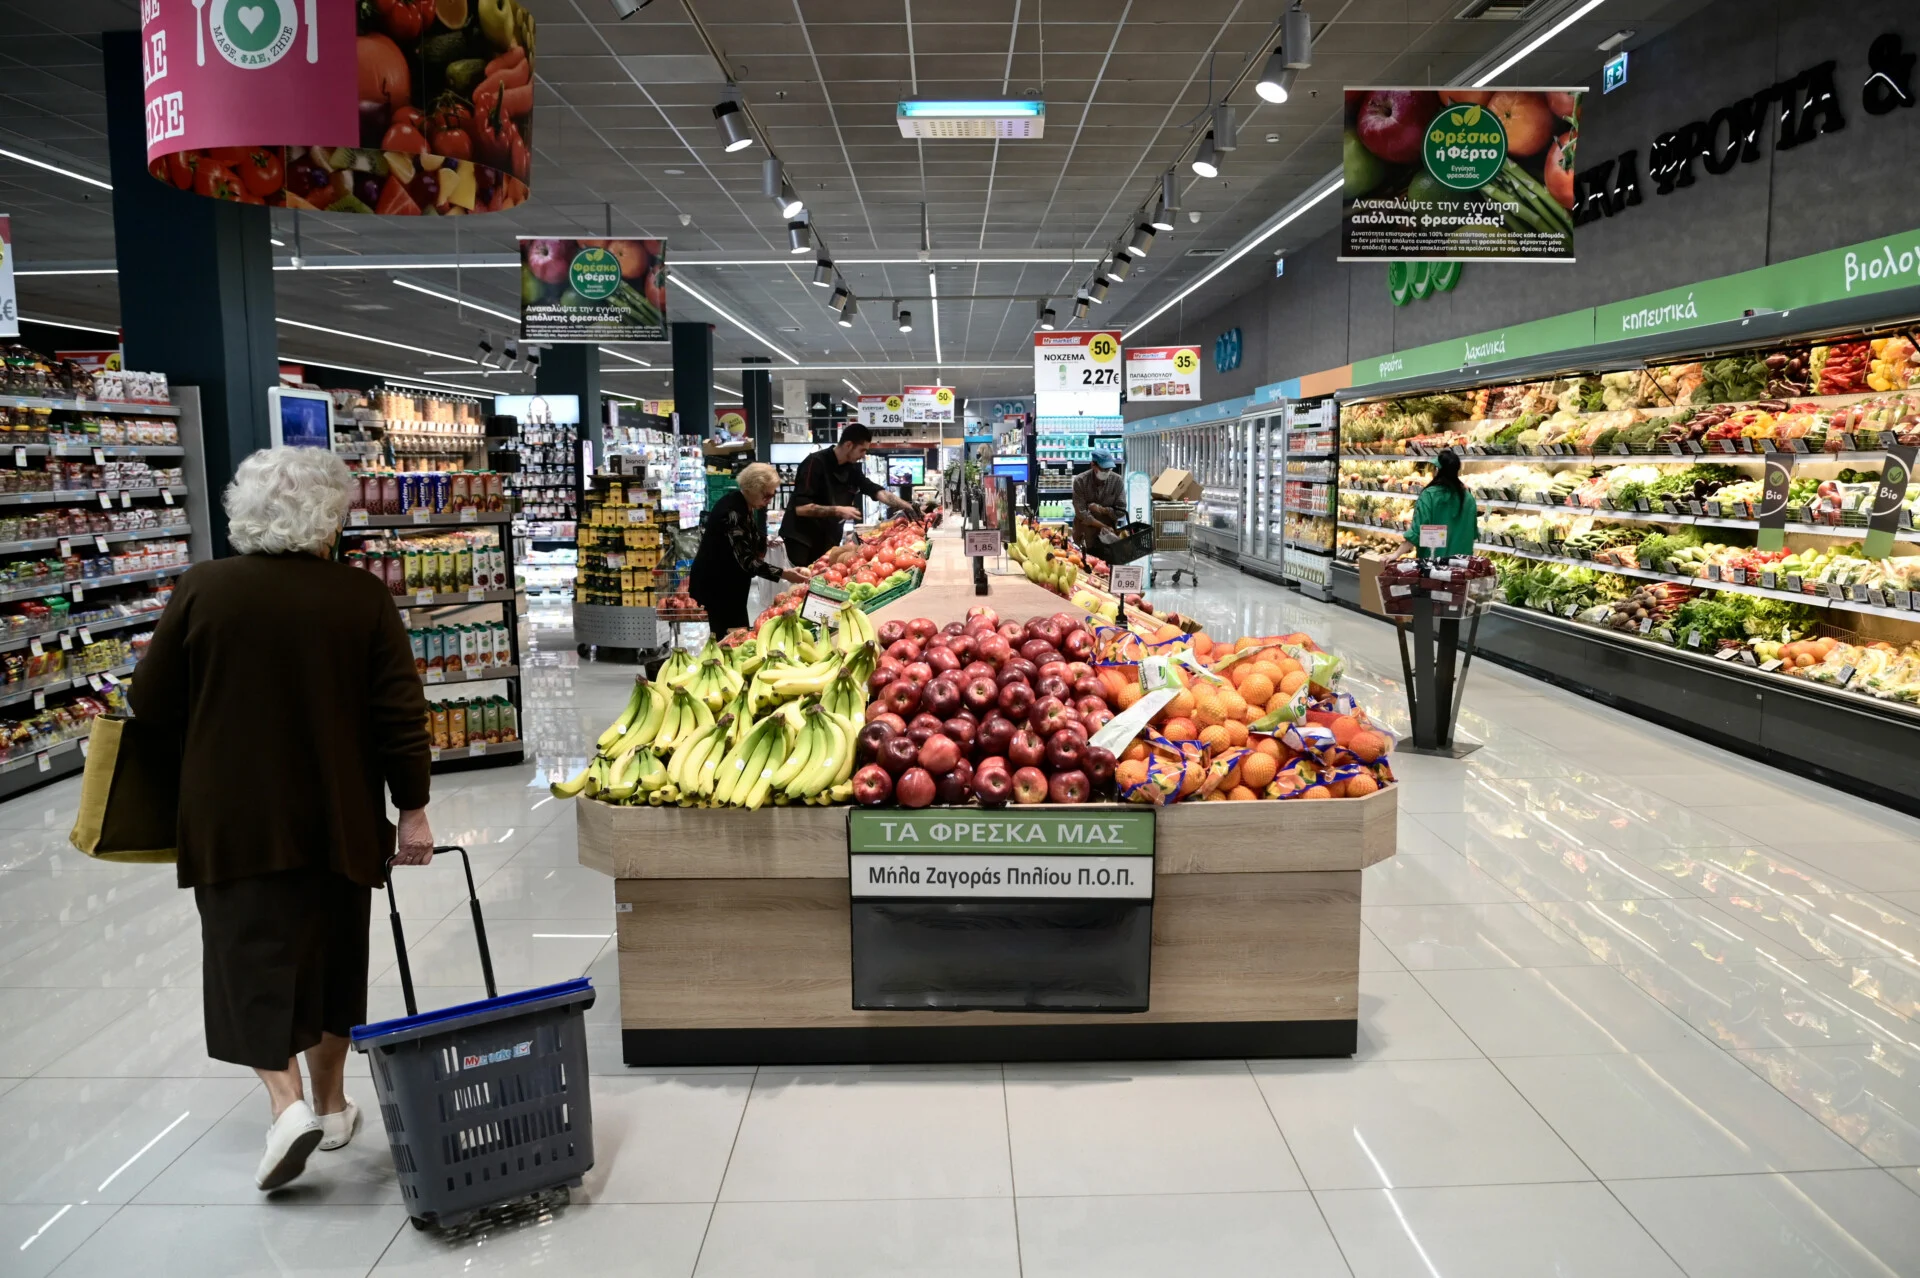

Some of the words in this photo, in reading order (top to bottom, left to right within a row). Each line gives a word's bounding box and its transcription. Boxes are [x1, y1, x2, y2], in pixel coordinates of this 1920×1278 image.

[212, 24, 238, 62] ΜΑΘΕ,
[269, 25, 294, 57] ΖΗΣΕ
[1649, 59, 1846, 196] ΦΡΟΥΤΑ
[1862, 33, 1917, 116] &
[1430, 128, 1501, 147] Φρέσκο
[1435, 146, 1446, 162] ή
[1447, 145, 1498, 162] Φέρτο
[1446, 171, 1480, 179] φρεσκάδας
[1451, 164, 1476, 172] Εγγύηση
[1352, 197, 1433, 213] Ανακαλύψτε
[1437, 200, 1460, 213] την
[1463, 198, 1519, 213] εγγύηση
[1351, 213, 1417, 227] απόλυτης
[1420, 213, 1505, 228] φρεσκάδας!
[1351, 230, 1384, 238] Δυνατότητα
[1385, 231, 1417, 239] επιστροφής
[573, 262, 618, 274] Φρέσκο
[577, 272, 584, 283] ή
[584, 272, 616, 283] Φέρτο
[525, 304, 578, 314] Ανακαλύψτε
[579, 306, 594, 314] την
[595, 305, 632, 314] εγγύηση
[1622, 291, 1698, 332] κηπευτικά
[525, 313, 568, 323] απόλυτης
[569, 313, 623, 323] φρεσκάδας!
[1464, 333, 1506, 361] λαχανικά
[1043, 353, 1086, 362] NOXZEMA
[1379, 354, 1403, 379] φρούτα
[1082, 368, 1120, 386] 2,27€
[626, 457, 646, 465] bianco
[1765, 489, 1782, 501] Bio
[1879, 486, 1898, 501] Bio
[879, 822, 920, 842] ΤΑ
[928, 822, 1047, 843] ΦΡΕΣΚΑ
[1057, 823, 1124, 844] ΜΑΣ
[869, 865, 920, 885] Μήλα
[926, 866, 1001, 889] Ζαγοράς
[1007, 866, 1072, 889] Πηλίου
[1077, 868, 1135, 886] Π.Ο.Π.
[465, 1056, 480, 1067] My
